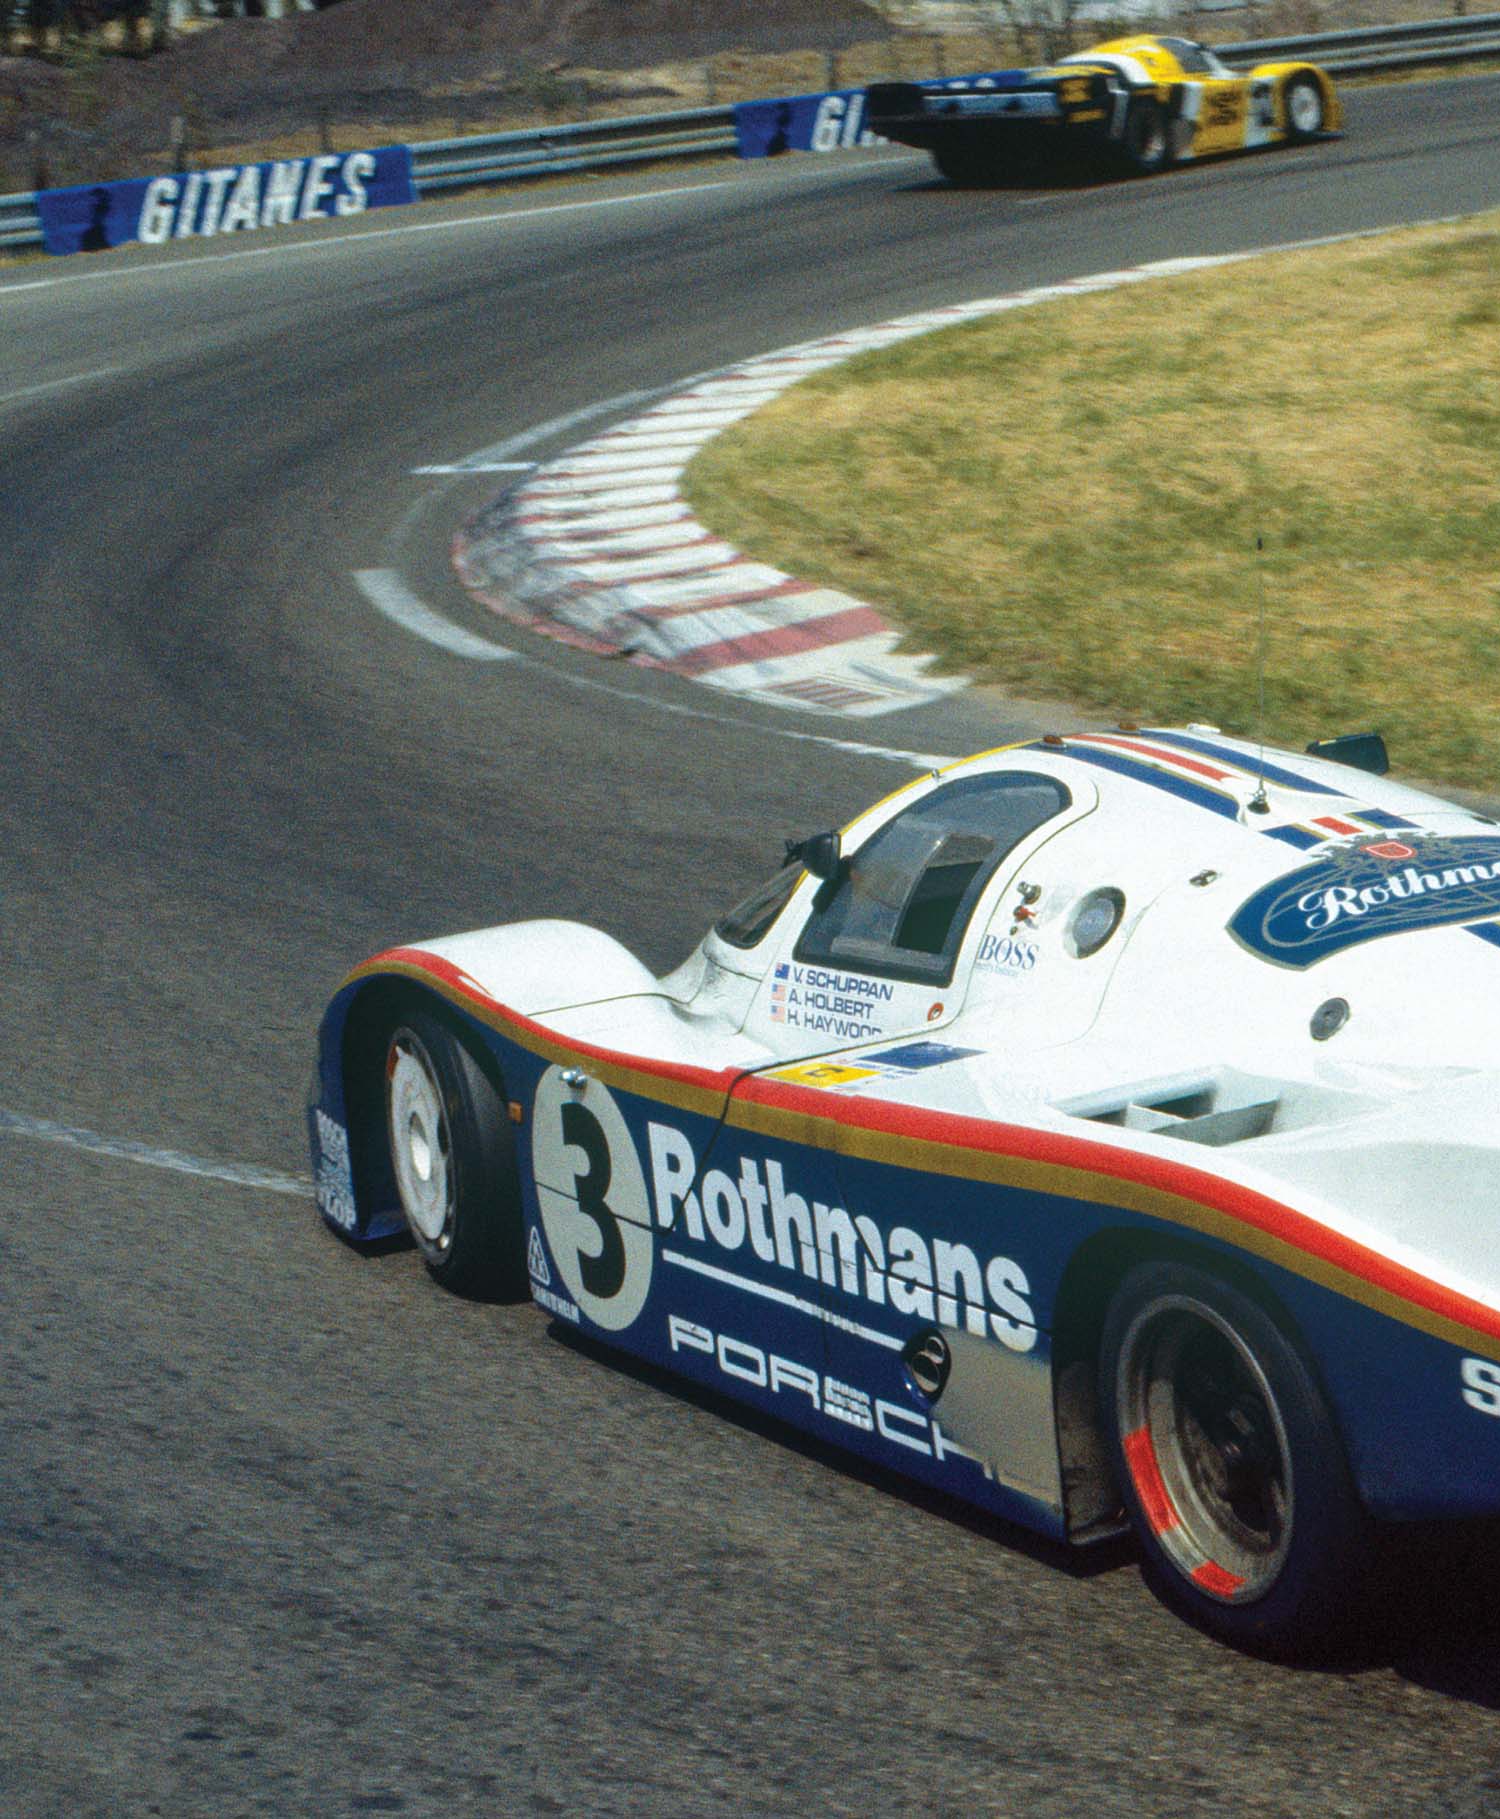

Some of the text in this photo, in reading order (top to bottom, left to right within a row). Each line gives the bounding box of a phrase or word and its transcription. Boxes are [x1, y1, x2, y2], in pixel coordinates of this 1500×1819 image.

[136, 152, 377, 244] GITANES
[793, 966, 894, 1001] V. SCHUPPAN
[979, 934, 1040, 971] BOSS
[786, 1009, 800, 1027] H.
[788, 987, 875, 1020] A. HOLBERT
[560, 1102, 627, 1299] 3
[647, 1121, 1038, 1353] Rothmans
[669, 1314, 994, 1481] PORSCH
